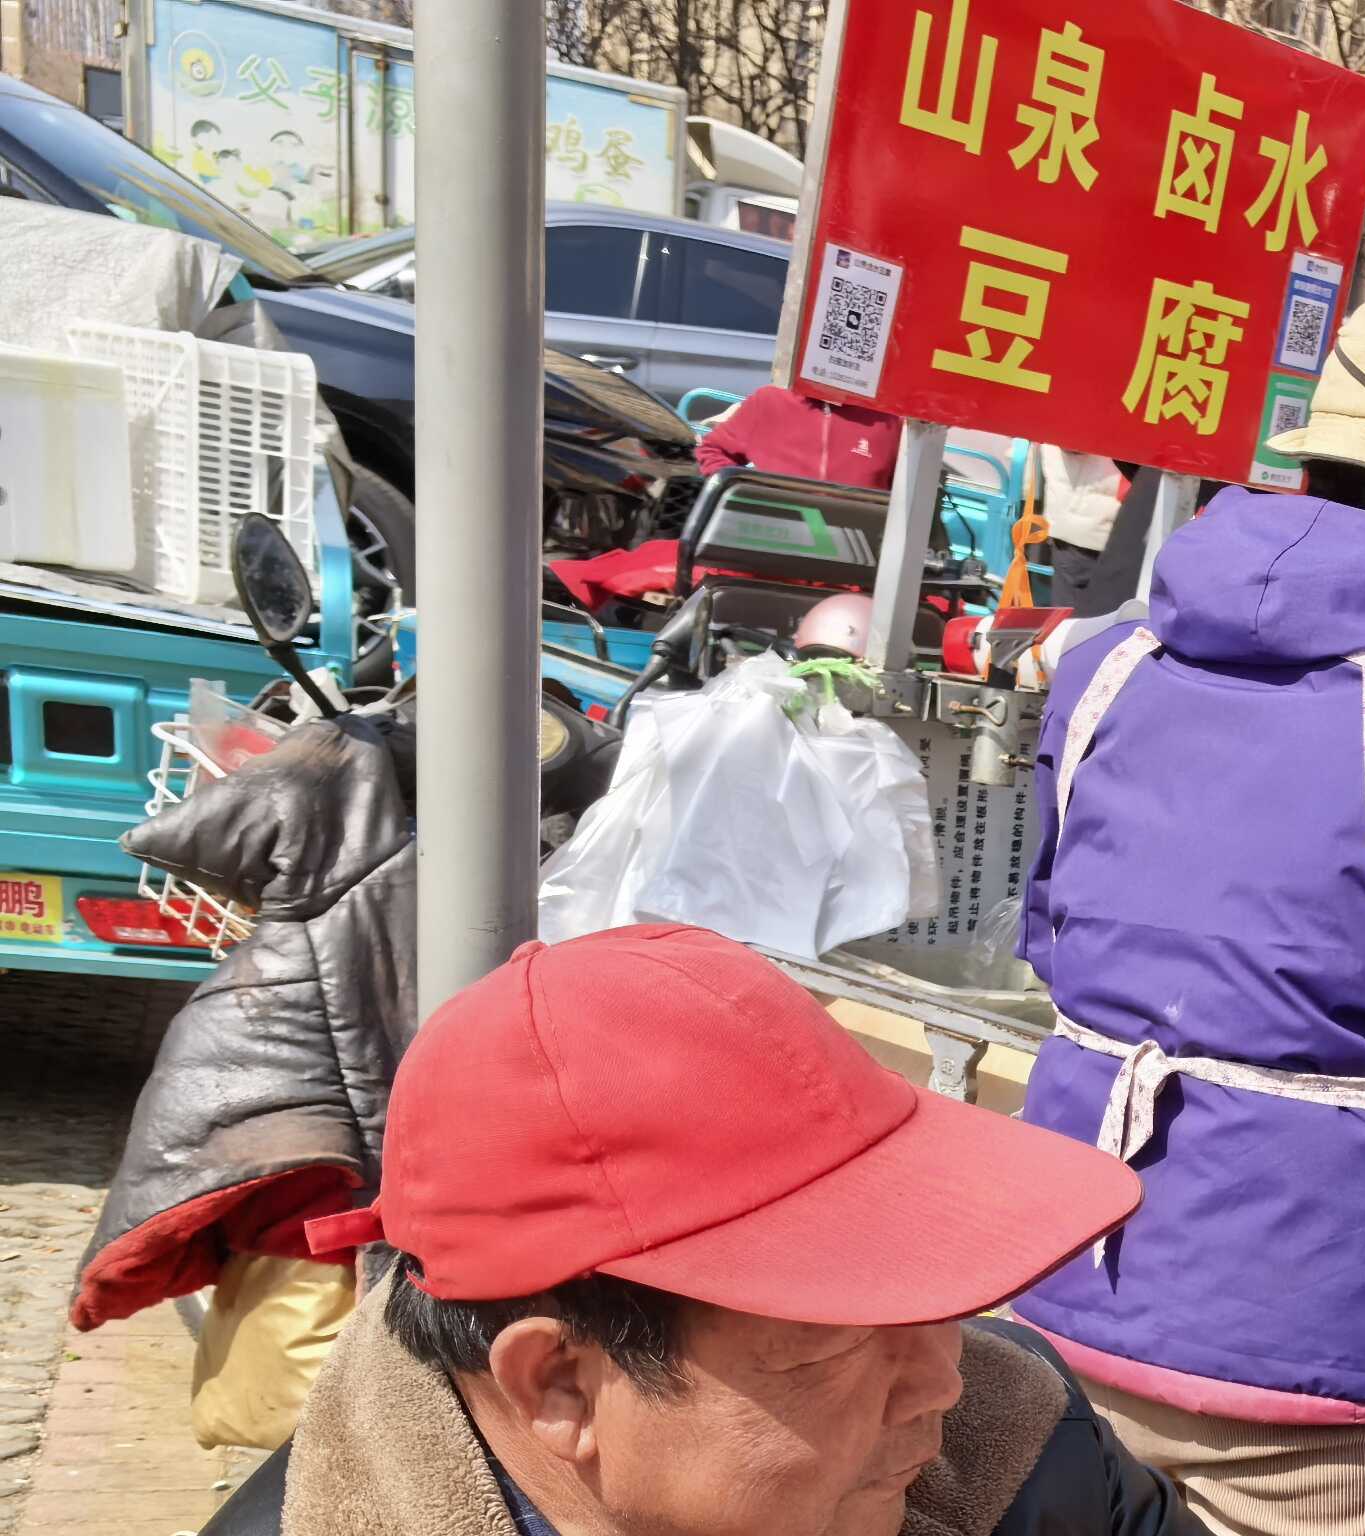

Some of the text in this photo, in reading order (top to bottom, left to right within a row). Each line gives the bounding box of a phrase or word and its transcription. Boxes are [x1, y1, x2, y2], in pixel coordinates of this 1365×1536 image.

[899, 0, 1328, 253] 山泉卤水
[931, 225, 1250, 436] 豆腐
